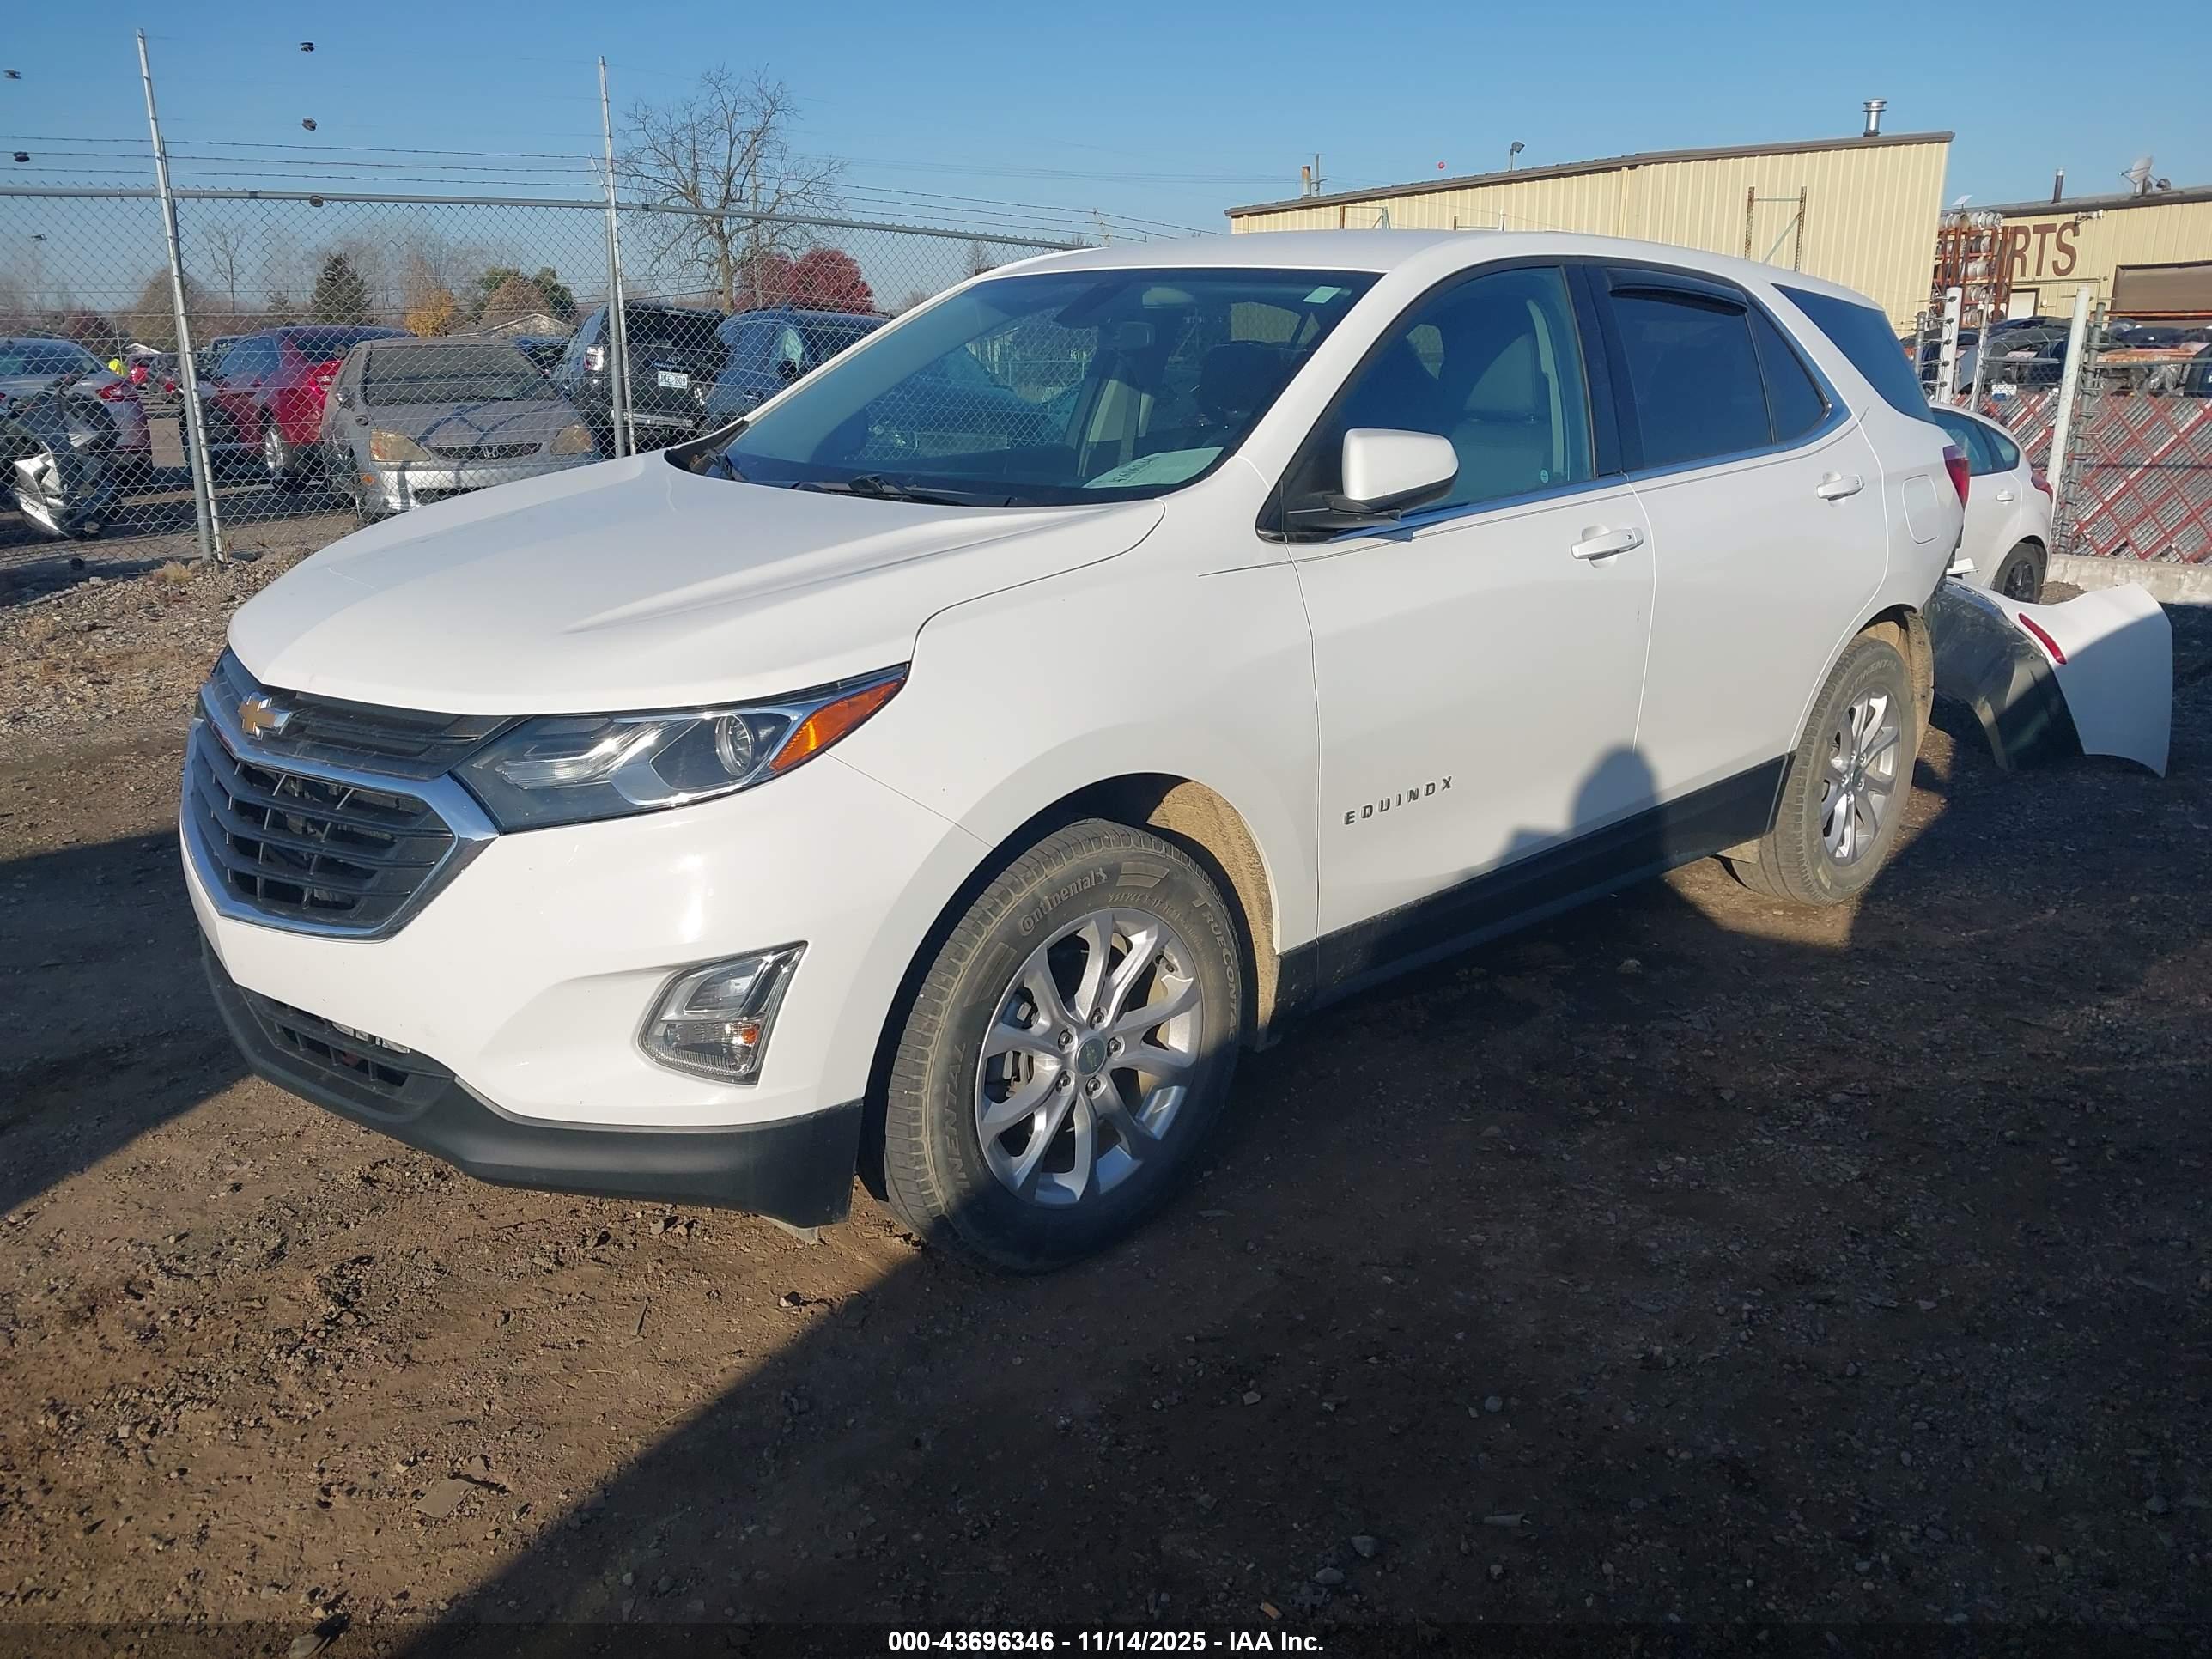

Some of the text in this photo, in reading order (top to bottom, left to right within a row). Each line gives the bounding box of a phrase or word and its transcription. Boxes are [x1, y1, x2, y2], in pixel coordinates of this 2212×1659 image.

[2009, 221, 2081, 277] RTS
[1344, 775, 1453, 826] EQUINOX
[1018, 870, 1097, 937] Continental
[944, 1042, 971, 1189] INENTAL
